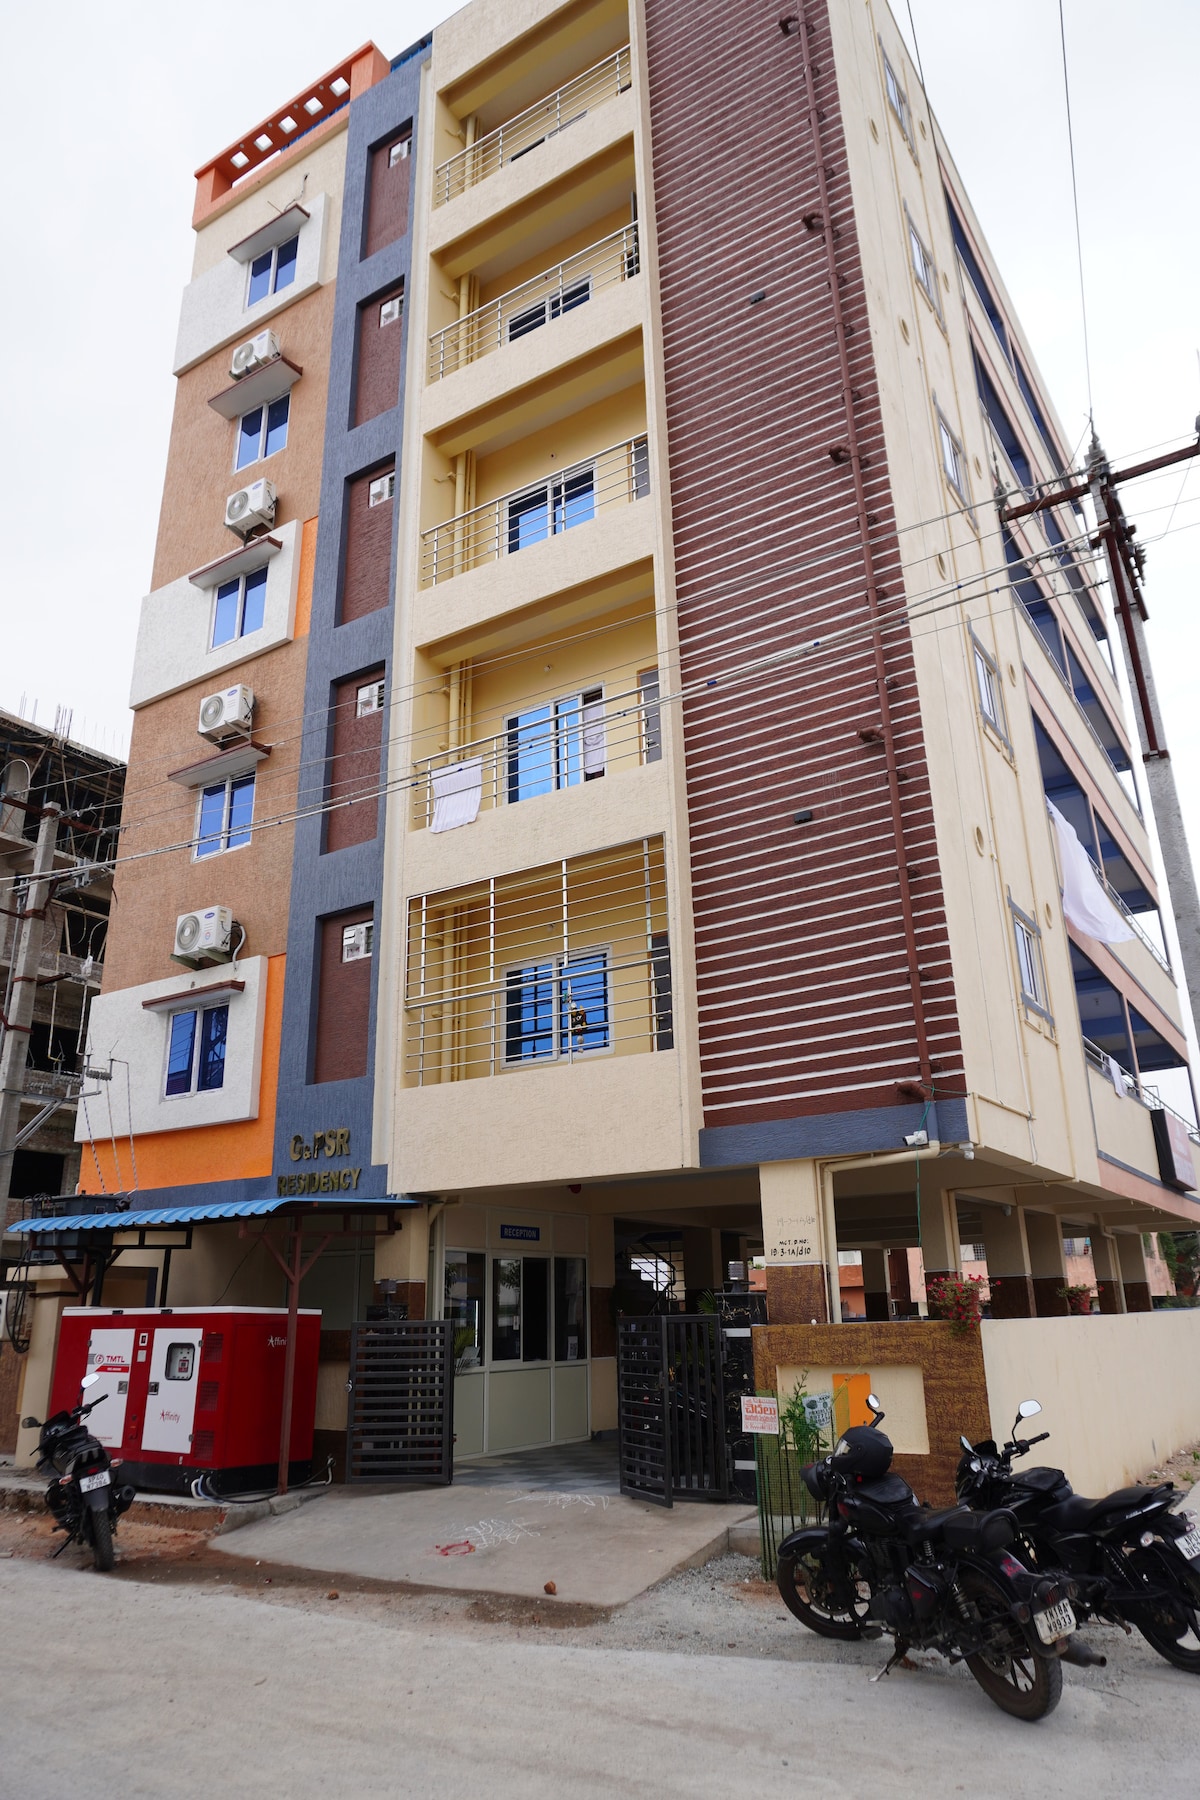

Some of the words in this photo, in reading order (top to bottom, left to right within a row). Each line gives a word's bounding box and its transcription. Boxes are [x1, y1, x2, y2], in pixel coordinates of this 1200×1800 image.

[277, 1167, 362, 1197] RESIDENCY
[503, 1227, 537, 1239] RECEPTION
[106, 1355, 125, 1363] TMTL
